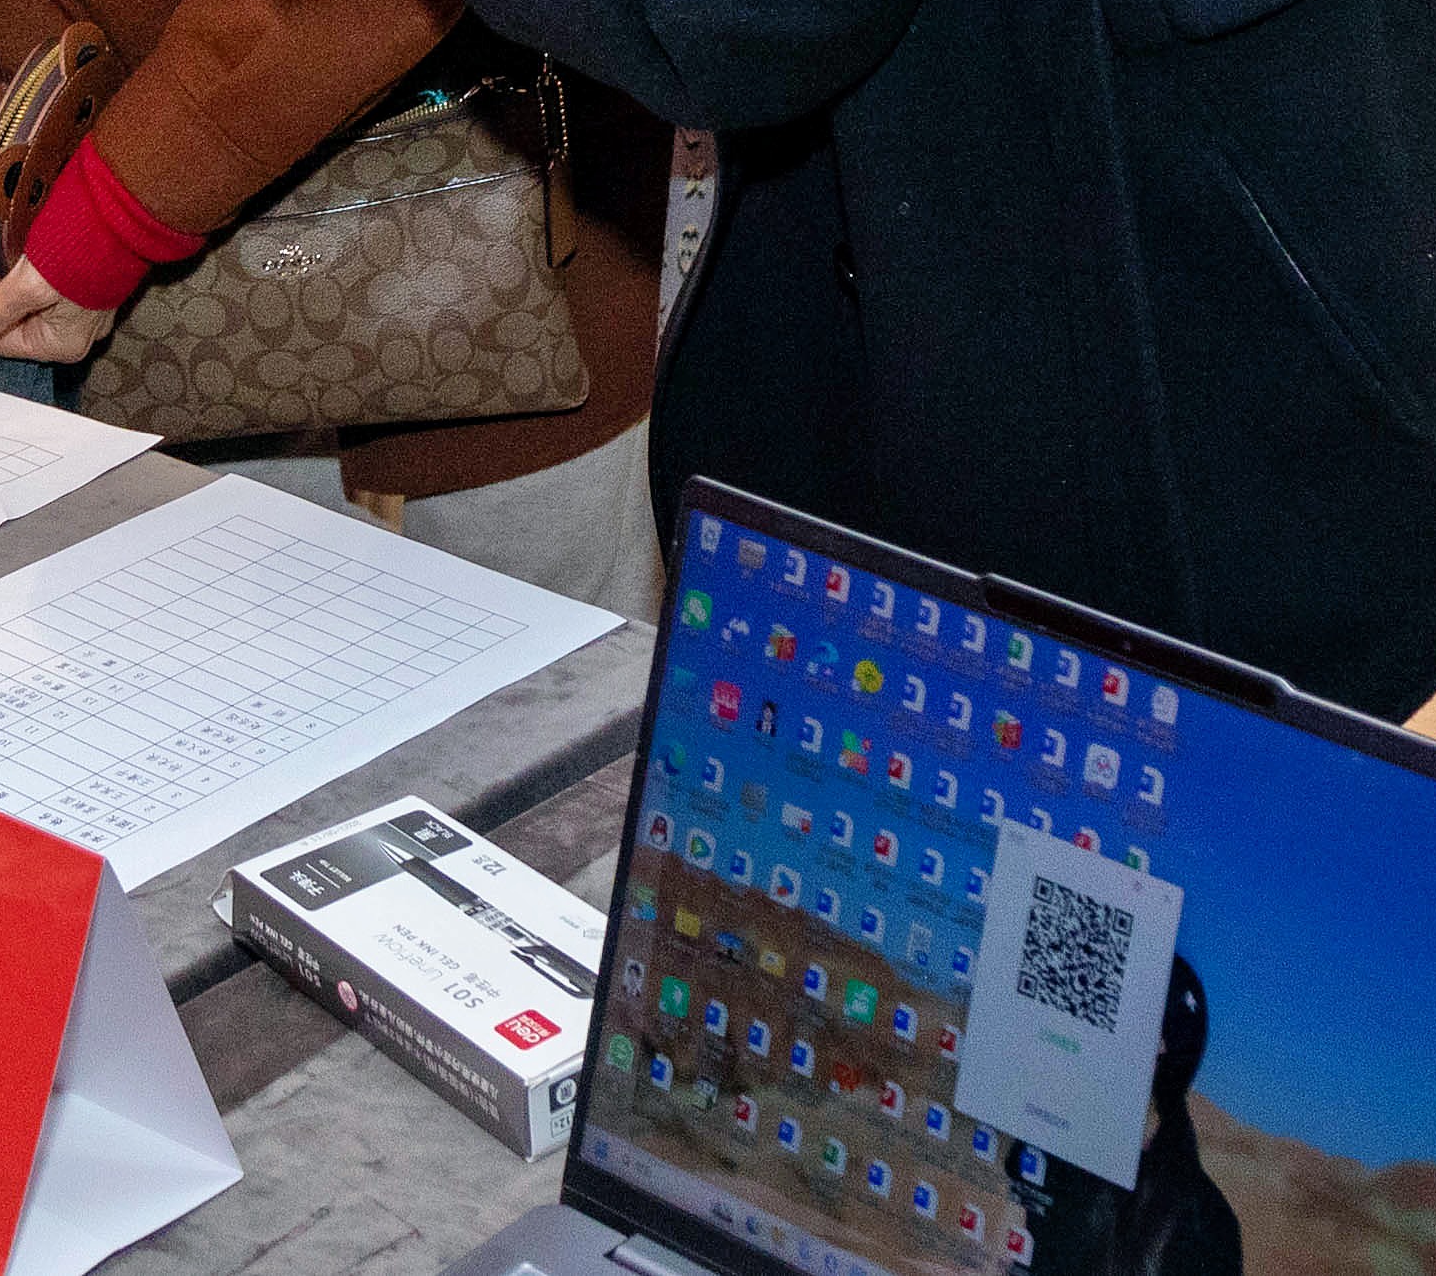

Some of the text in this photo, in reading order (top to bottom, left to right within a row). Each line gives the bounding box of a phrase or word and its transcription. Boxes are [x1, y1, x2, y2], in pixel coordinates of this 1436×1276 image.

[53, 711, 68, 719] 12
[25, 726, 39, 734] 11
[290, 871, 324, 896] 子弹头
[394, 925, 499, 997] 中性笔 GEL INK PEN
[444, 983, 483, 1008] S01
[506, 1020, 539, 1042] deli
